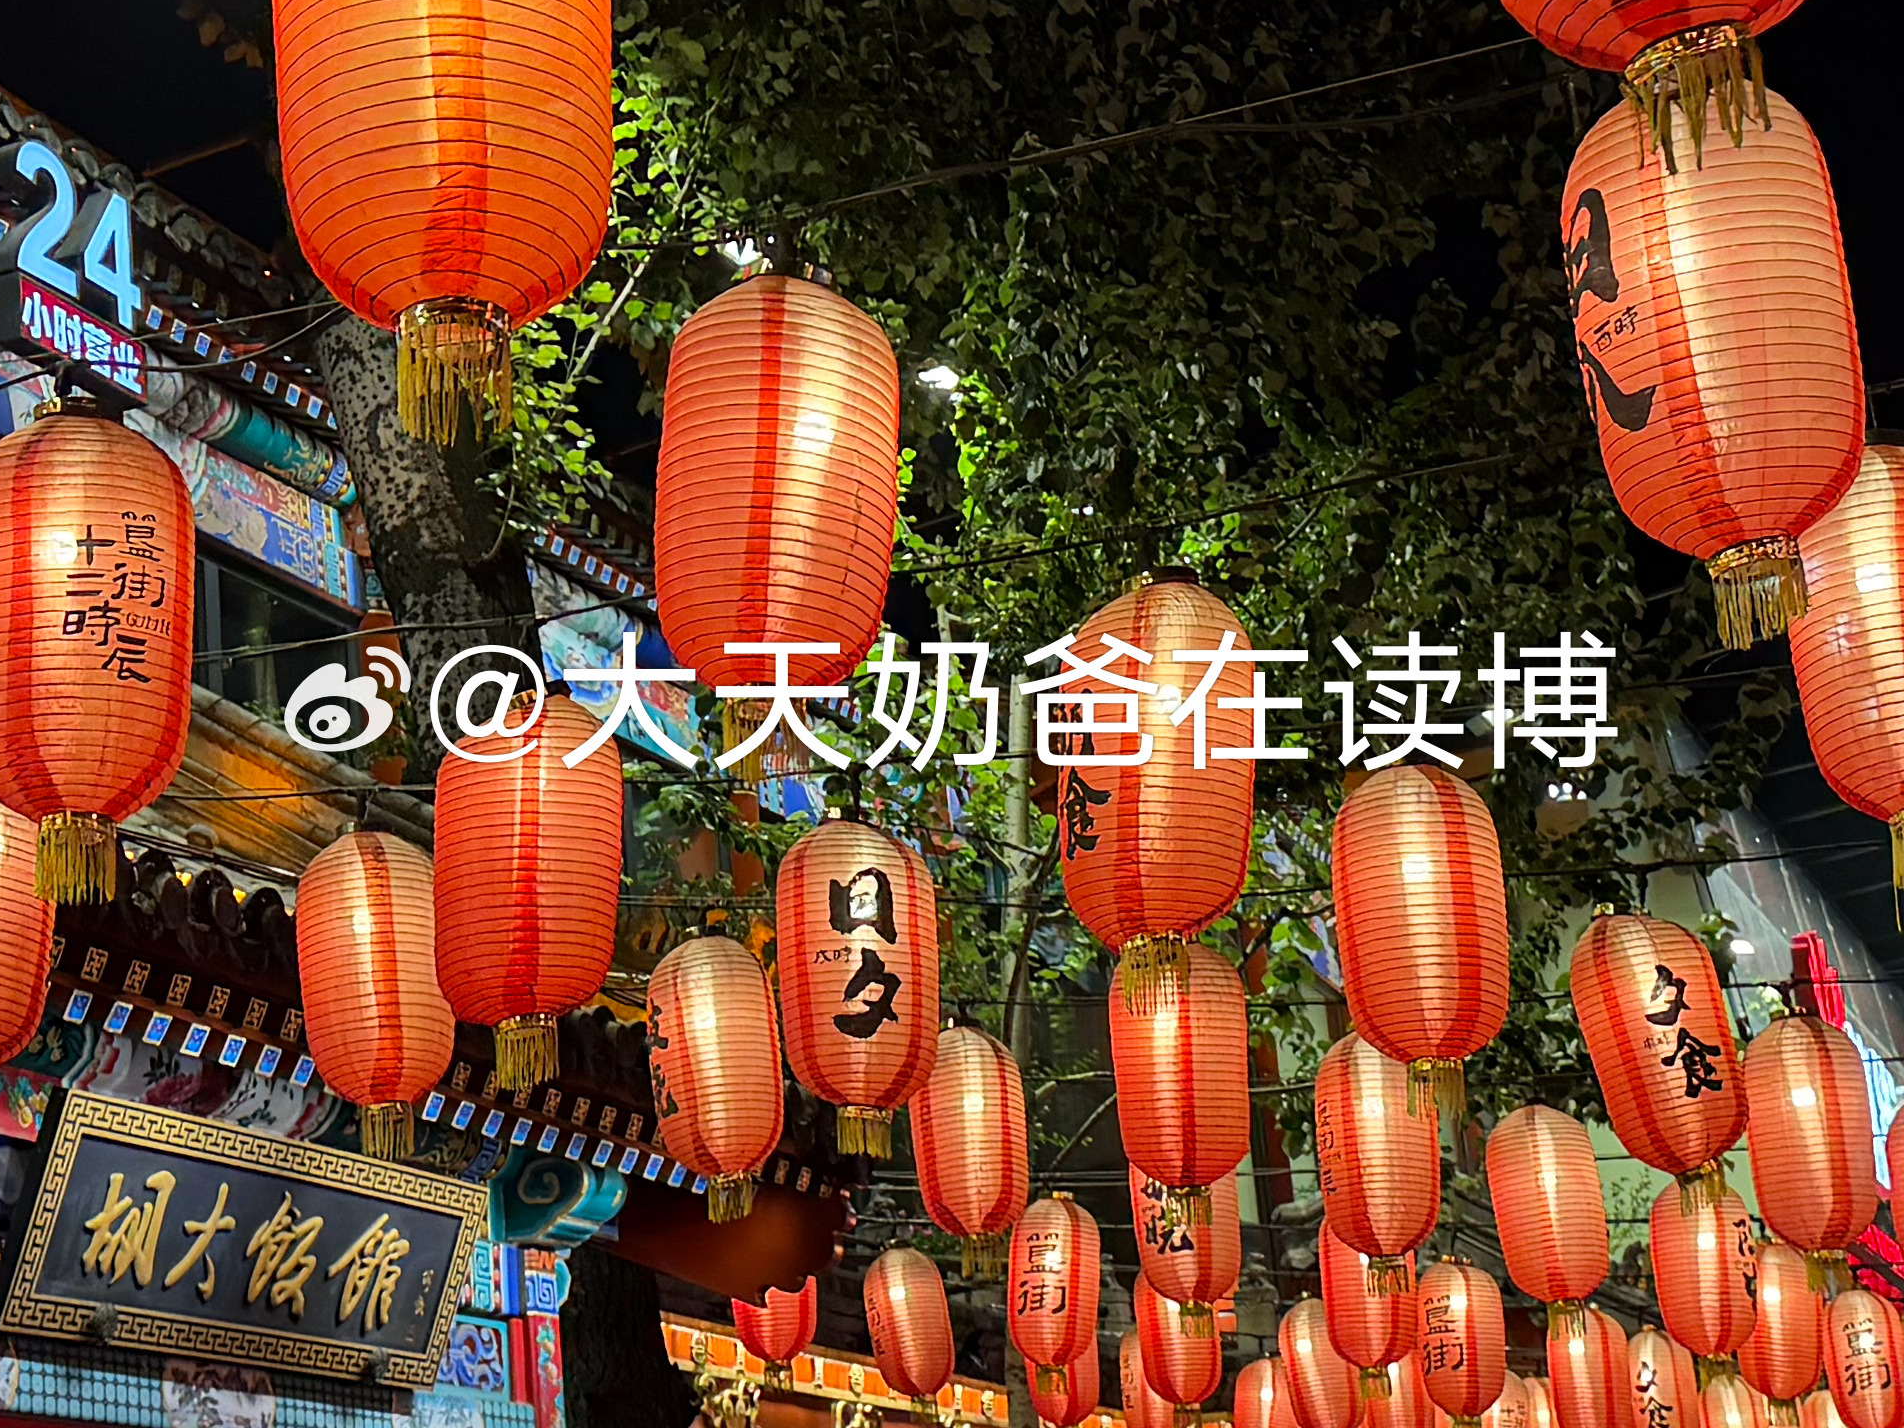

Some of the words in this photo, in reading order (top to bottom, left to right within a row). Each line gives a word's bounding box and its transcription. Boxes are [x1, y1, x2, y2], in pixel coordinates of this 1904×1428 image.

[16, 142, 142, 330] 24
[22, 291, 142, 394] 小时营业
[112, 509, 165, 607] 簋街
[1644, 963, 1724, 1098] 夕食
[1016, 1232, 1067, 1316] 簋街
[1422, 1294, 1465, 1377] 簋街
[1842, 1317, 1892, 1397] 簋街
